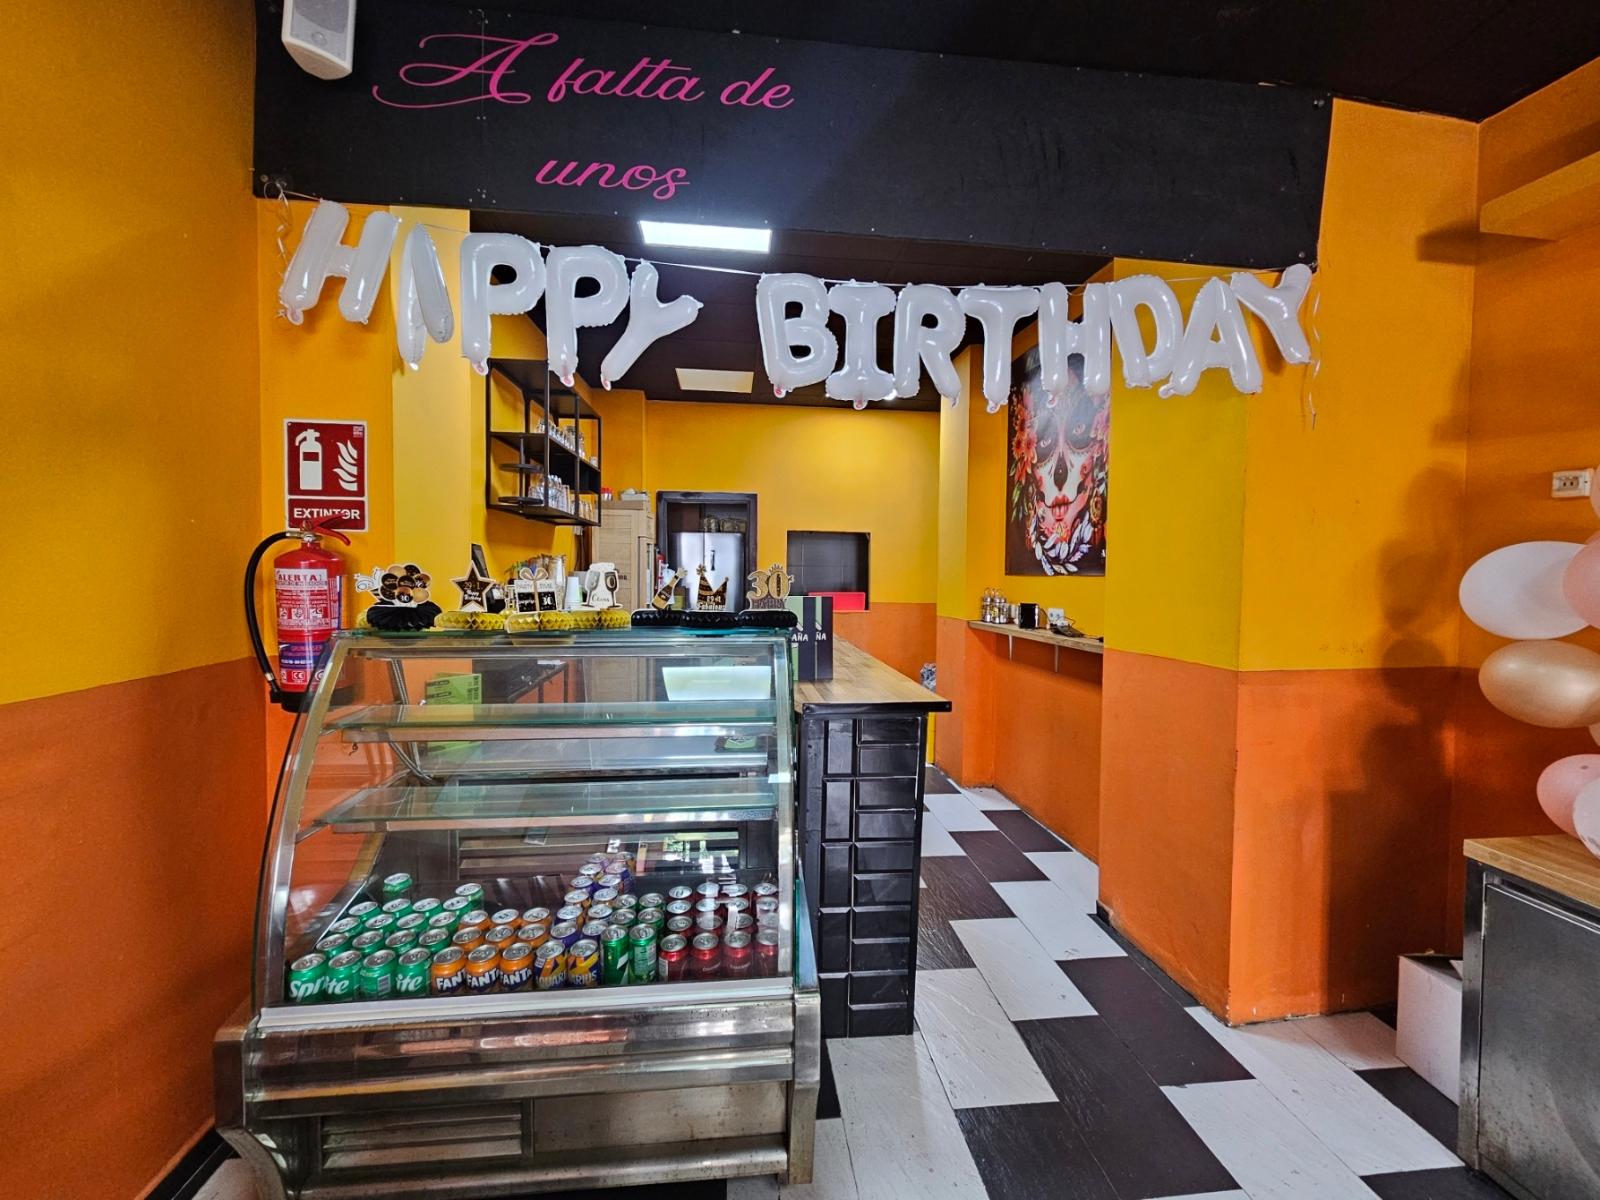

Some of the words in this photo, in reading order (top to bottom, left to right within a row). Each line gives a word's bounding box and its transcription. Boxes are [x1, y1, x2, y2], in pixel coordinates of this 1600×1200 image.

[372, 33, 560, 108] A
[547, 57, 705, 102] falta
[720, 67, 795, 109] de
[535, 159, 690, 200] unos
[756, 263, 1313, 414] BIRTHDAY
[746, 570, 790, 600] 30
